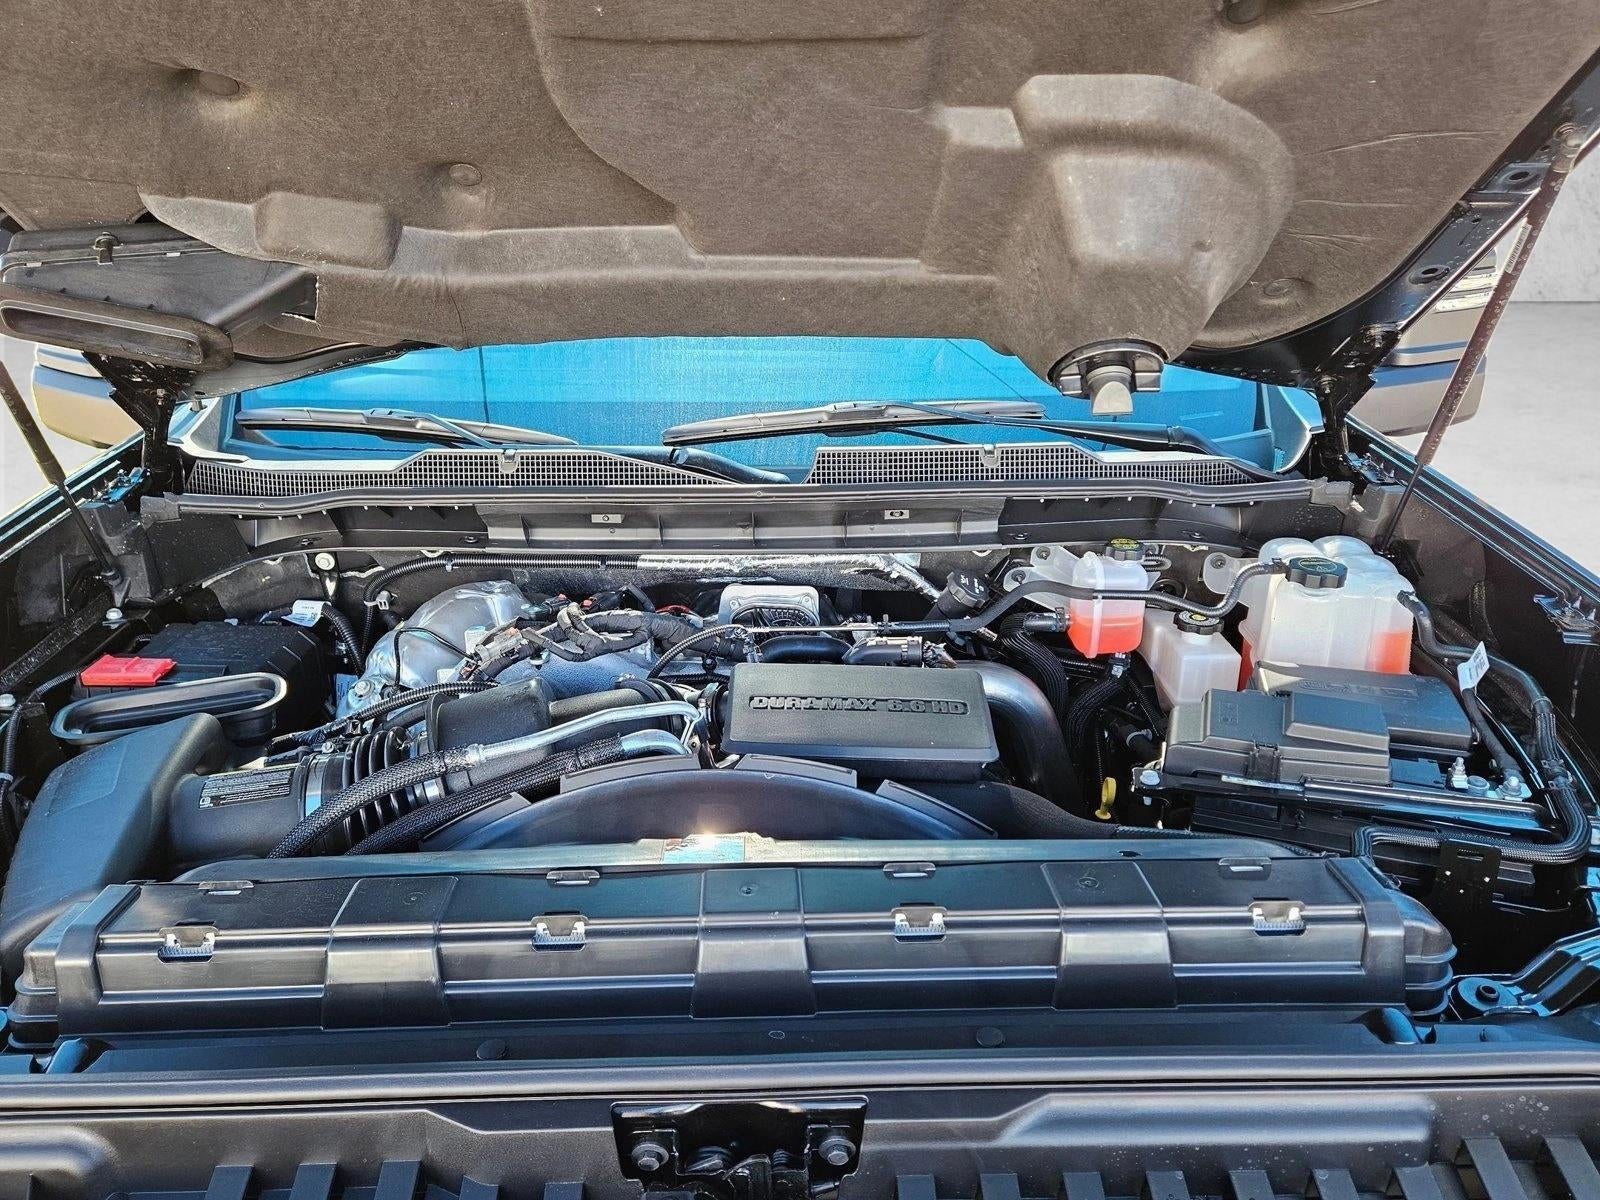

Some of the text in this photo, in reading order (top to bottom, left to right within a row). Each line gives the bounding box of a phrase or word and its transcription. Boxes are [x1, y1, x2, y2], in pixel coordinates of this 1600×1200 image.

[752, 696, 966, 714] DURAMAX 6.6 HD
